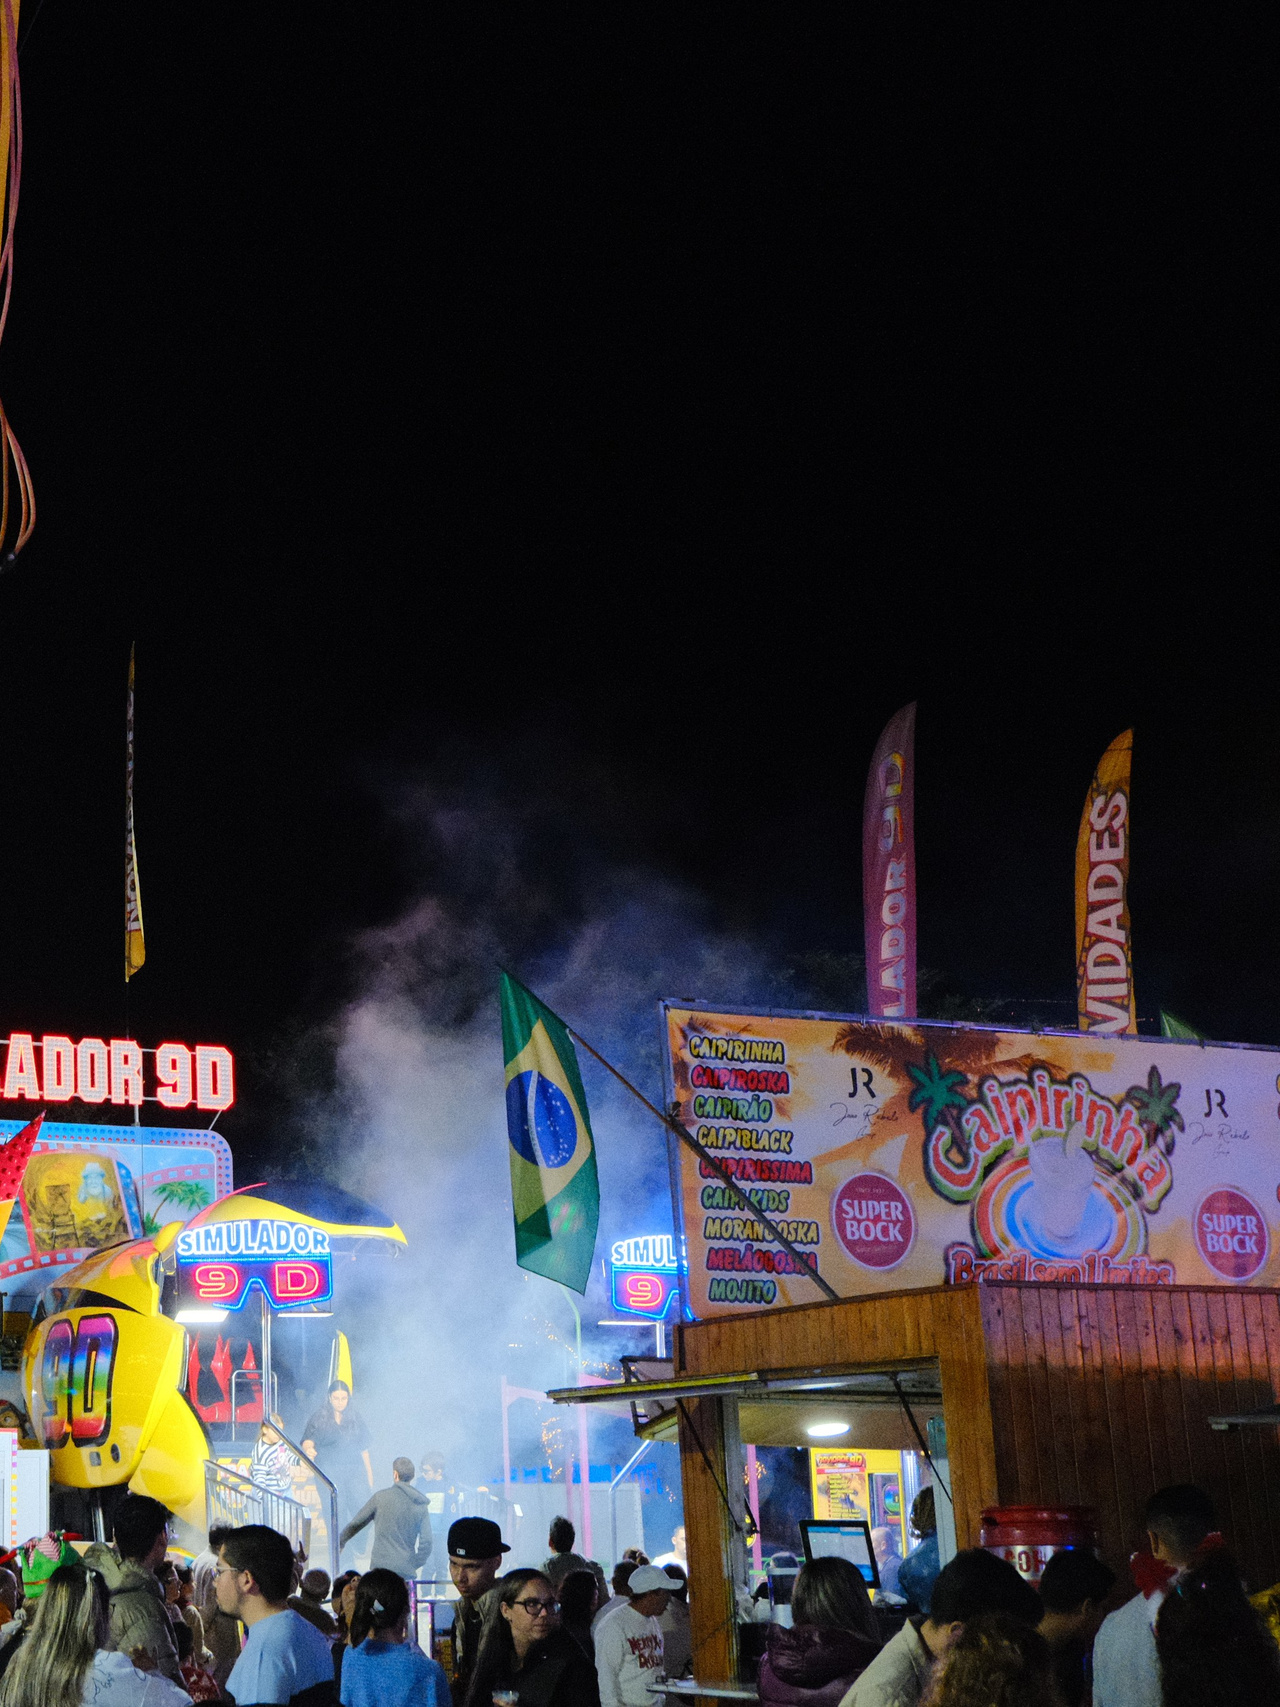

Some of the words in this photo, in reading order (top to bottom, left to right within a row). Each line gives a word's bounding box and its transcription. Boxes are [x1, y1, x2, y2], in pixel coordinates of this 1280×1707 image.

[690, 1035, 785, 1064] CAIPIRINHA
[156, 1043, 235, 1111] 9D
[692, 1065, 790, 1094] CAIPIROSKA
[848, 1067, 876, 1098] JR
[694, 1093, 773, 1123] CAIPIRÃO
[1204, 1088, 1229, 1118] JR
[697, 1125, 794, 1155] CAIPIBLACK
[928, 1068, 1173, 1202] Caipirinha
[748, 1188, 791, 1213] KIDS
[842, 1198, 904, 1220] SUPER
[177, 1220, 331, 1255] SIMULADOR
[845, 1220, 904, 1242] BOCK
[1202, 1213, 1259, 1233] SUPER
[611, 1235, 688, 1267] SIMUL
[1206, 1233, 1259, 1254] BOCK
[195, 1264, 239, 1297] 9
[275, 1263, 319, 1297] D
[626, 1275, 663, 1307] 9
[709, 1278, 777, 1304] MOJITO
